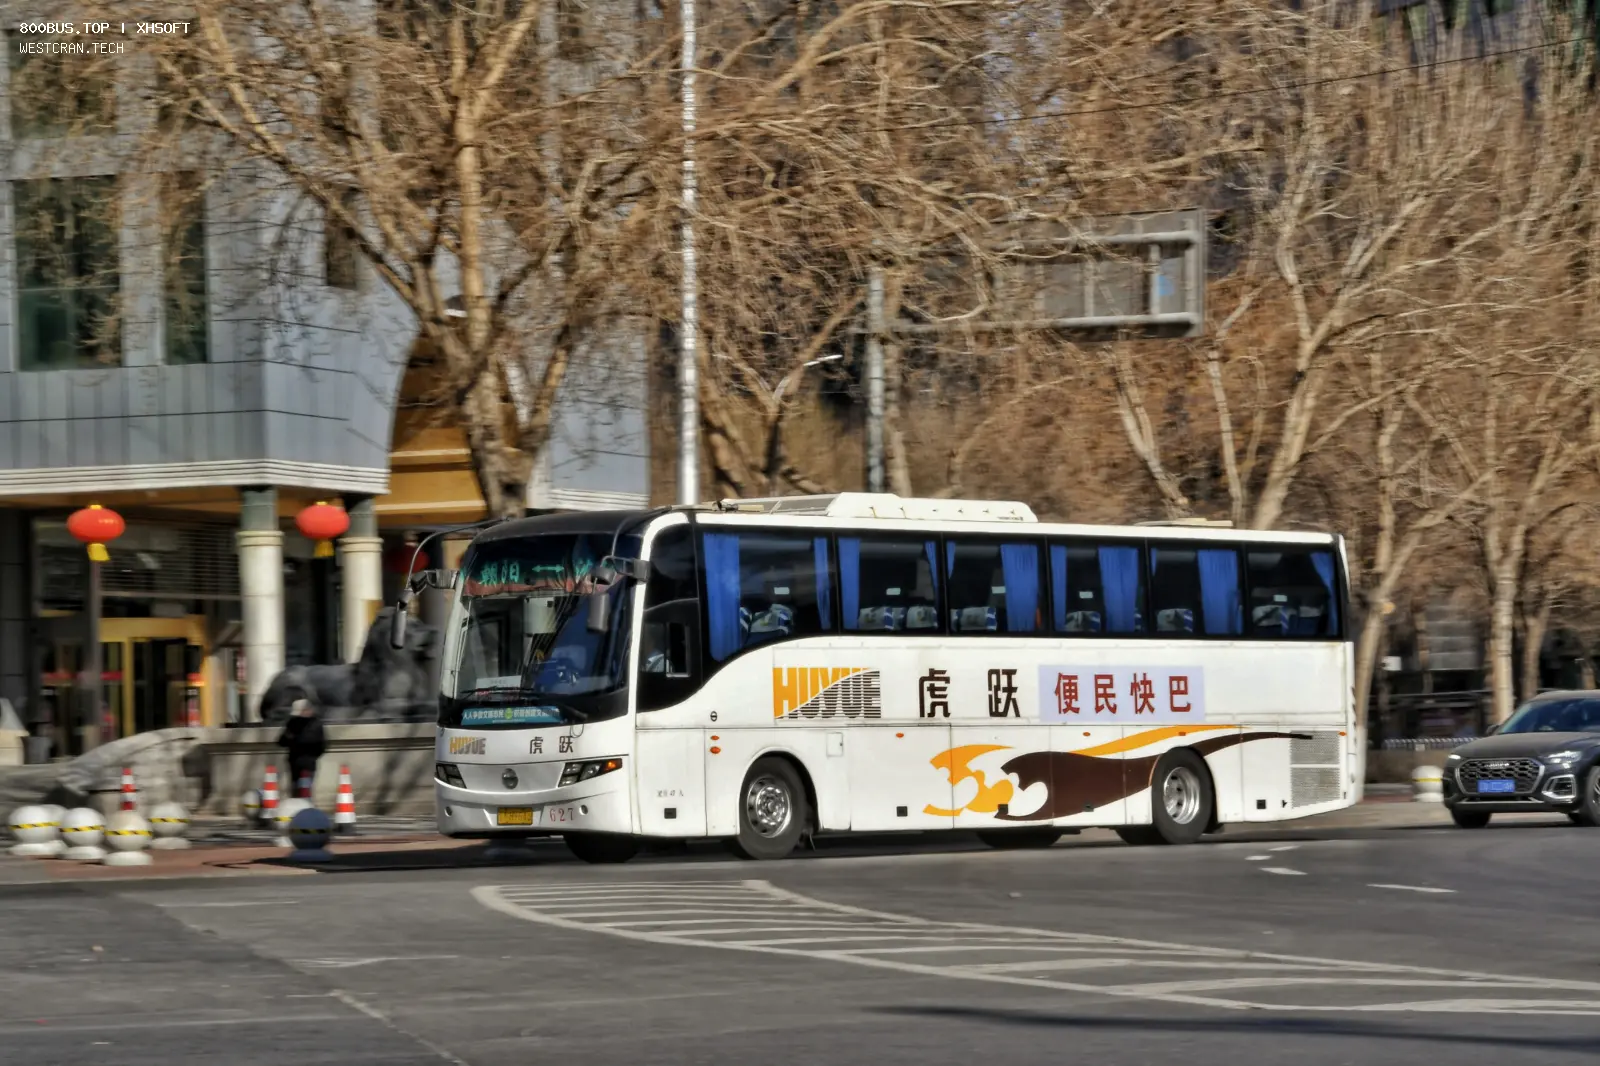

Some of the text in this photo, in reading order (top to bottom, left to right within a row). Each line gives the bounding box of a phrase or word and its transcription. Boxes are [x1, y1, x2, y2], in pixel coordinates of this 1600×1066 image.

[773, 667, 881, 719] HUYUE
[919, 668, 1020, 718] 虎跃
[1054, 672, 1191, 715] 便民快巴
[449, 736, 487, 755] HUYUE
[529, 735, 574, 755] 虎跃
[549, 807, 575, 822] 627
